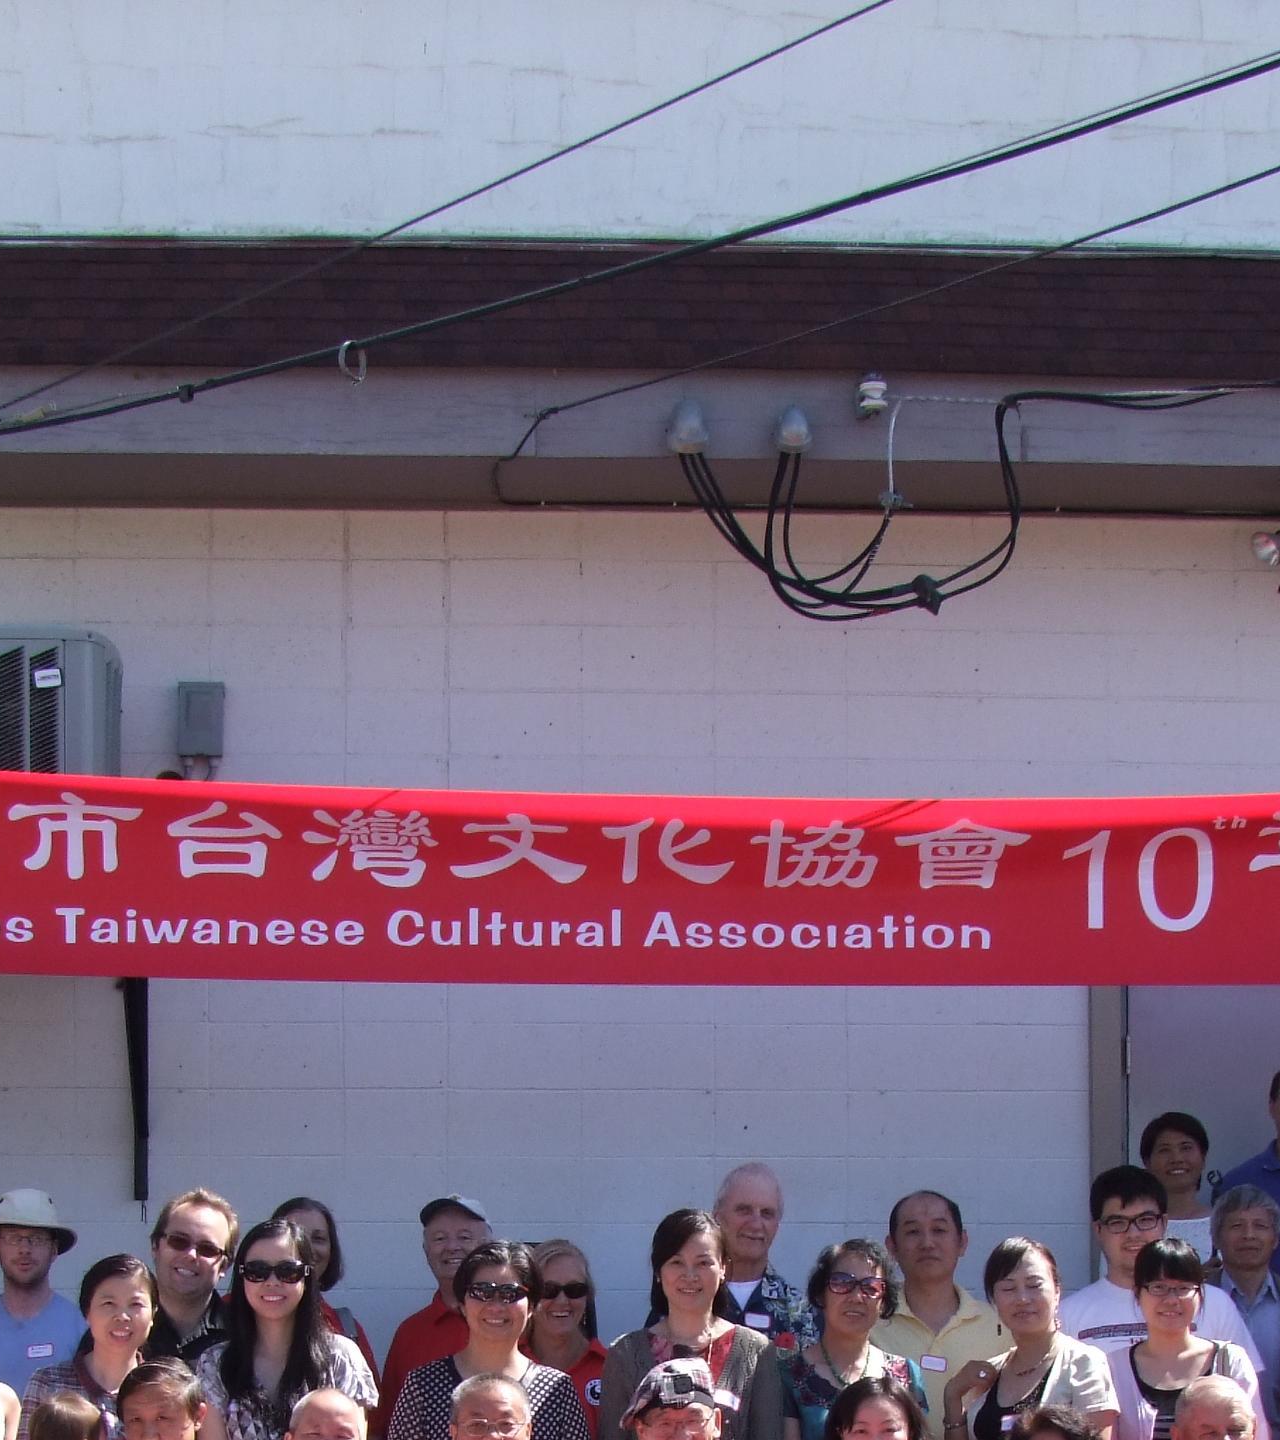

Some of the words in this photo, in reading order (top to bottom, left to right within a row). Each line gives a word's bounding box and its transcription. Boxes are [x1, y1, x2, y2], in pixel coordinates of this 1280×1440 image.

[55, 907, 365, 947] Taiwanese
[387, 907, 622, 947] Cultural
[643, 911, 991, 950] Association
